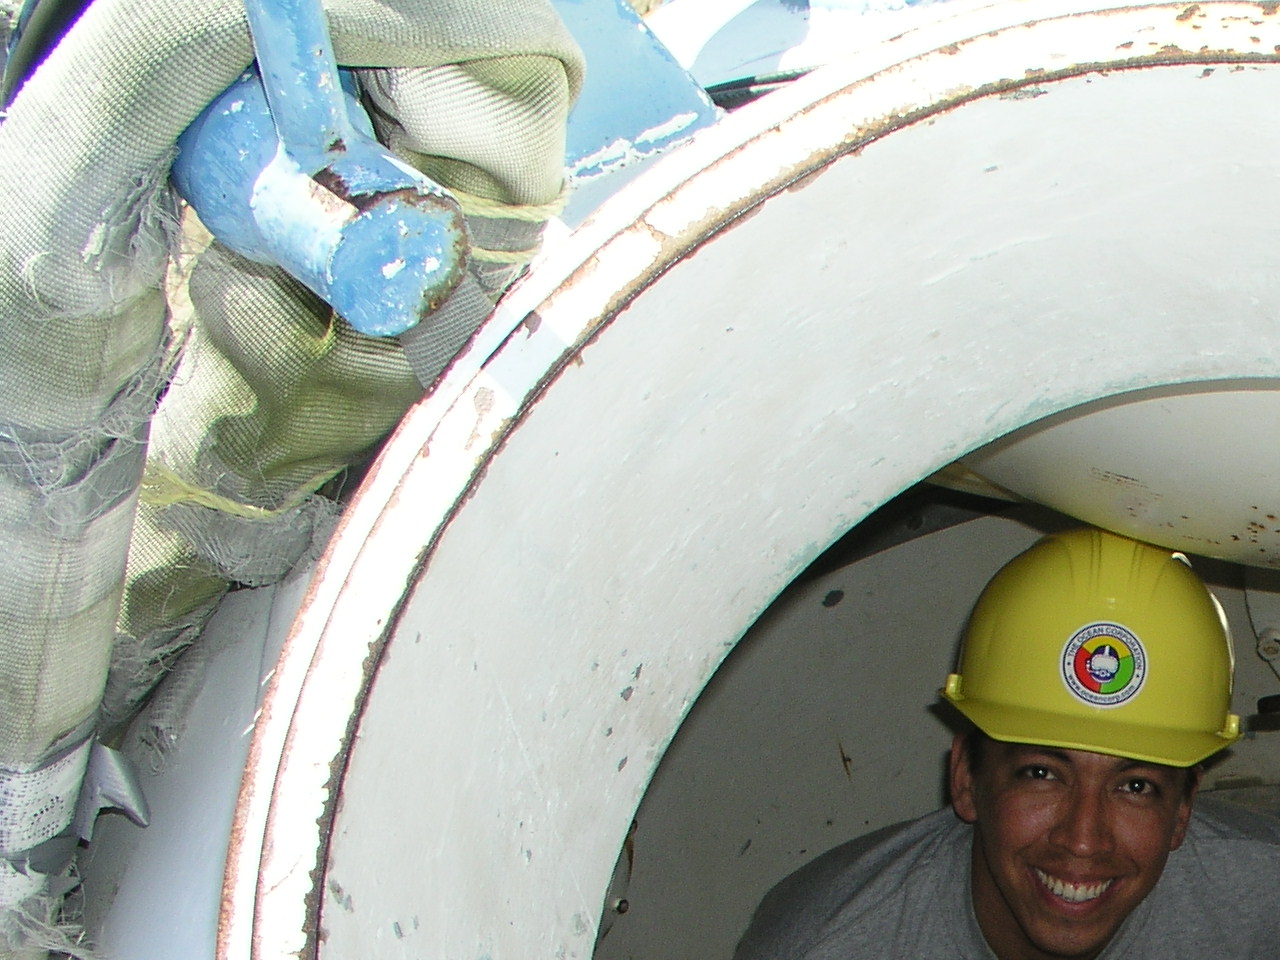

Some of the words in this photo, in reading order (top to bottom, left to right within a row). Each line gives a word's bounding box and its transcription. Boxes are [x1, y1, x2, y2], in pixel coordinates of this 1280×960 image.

[1068, 642, 1079, 656] THE
[1077, 627, 1104, 643] OCEAN
[1105, 627, 1142, 670] CORPORATION
